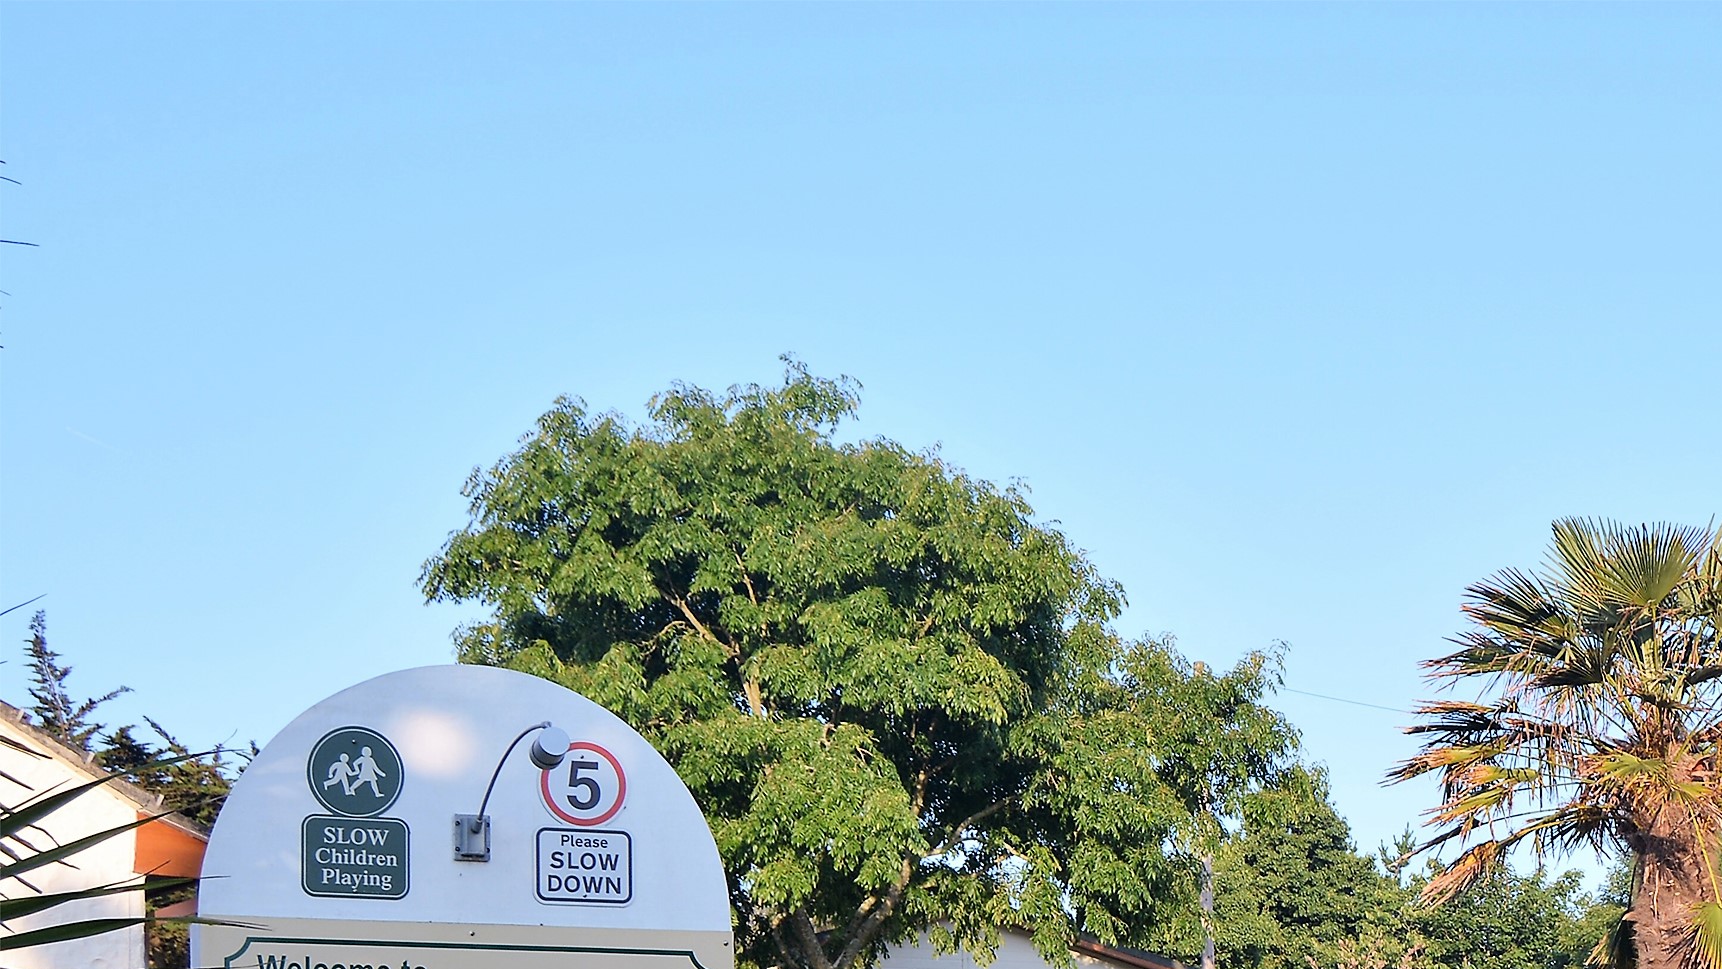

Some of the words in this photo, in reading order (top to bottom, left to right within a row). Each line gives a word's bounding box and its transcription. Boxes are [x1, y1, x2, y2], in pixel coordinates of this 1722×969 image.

[566, 760, 601, 811] 5
[323, 827, 389, 846] SLOW
[560, 834, 608, 850] Please
[315, 847, 398, 869] Children
[550, 851, 619, 872] SLOW
[321, 868, 392, 890] Playing
[547, 873, 622, 895] DOWN
